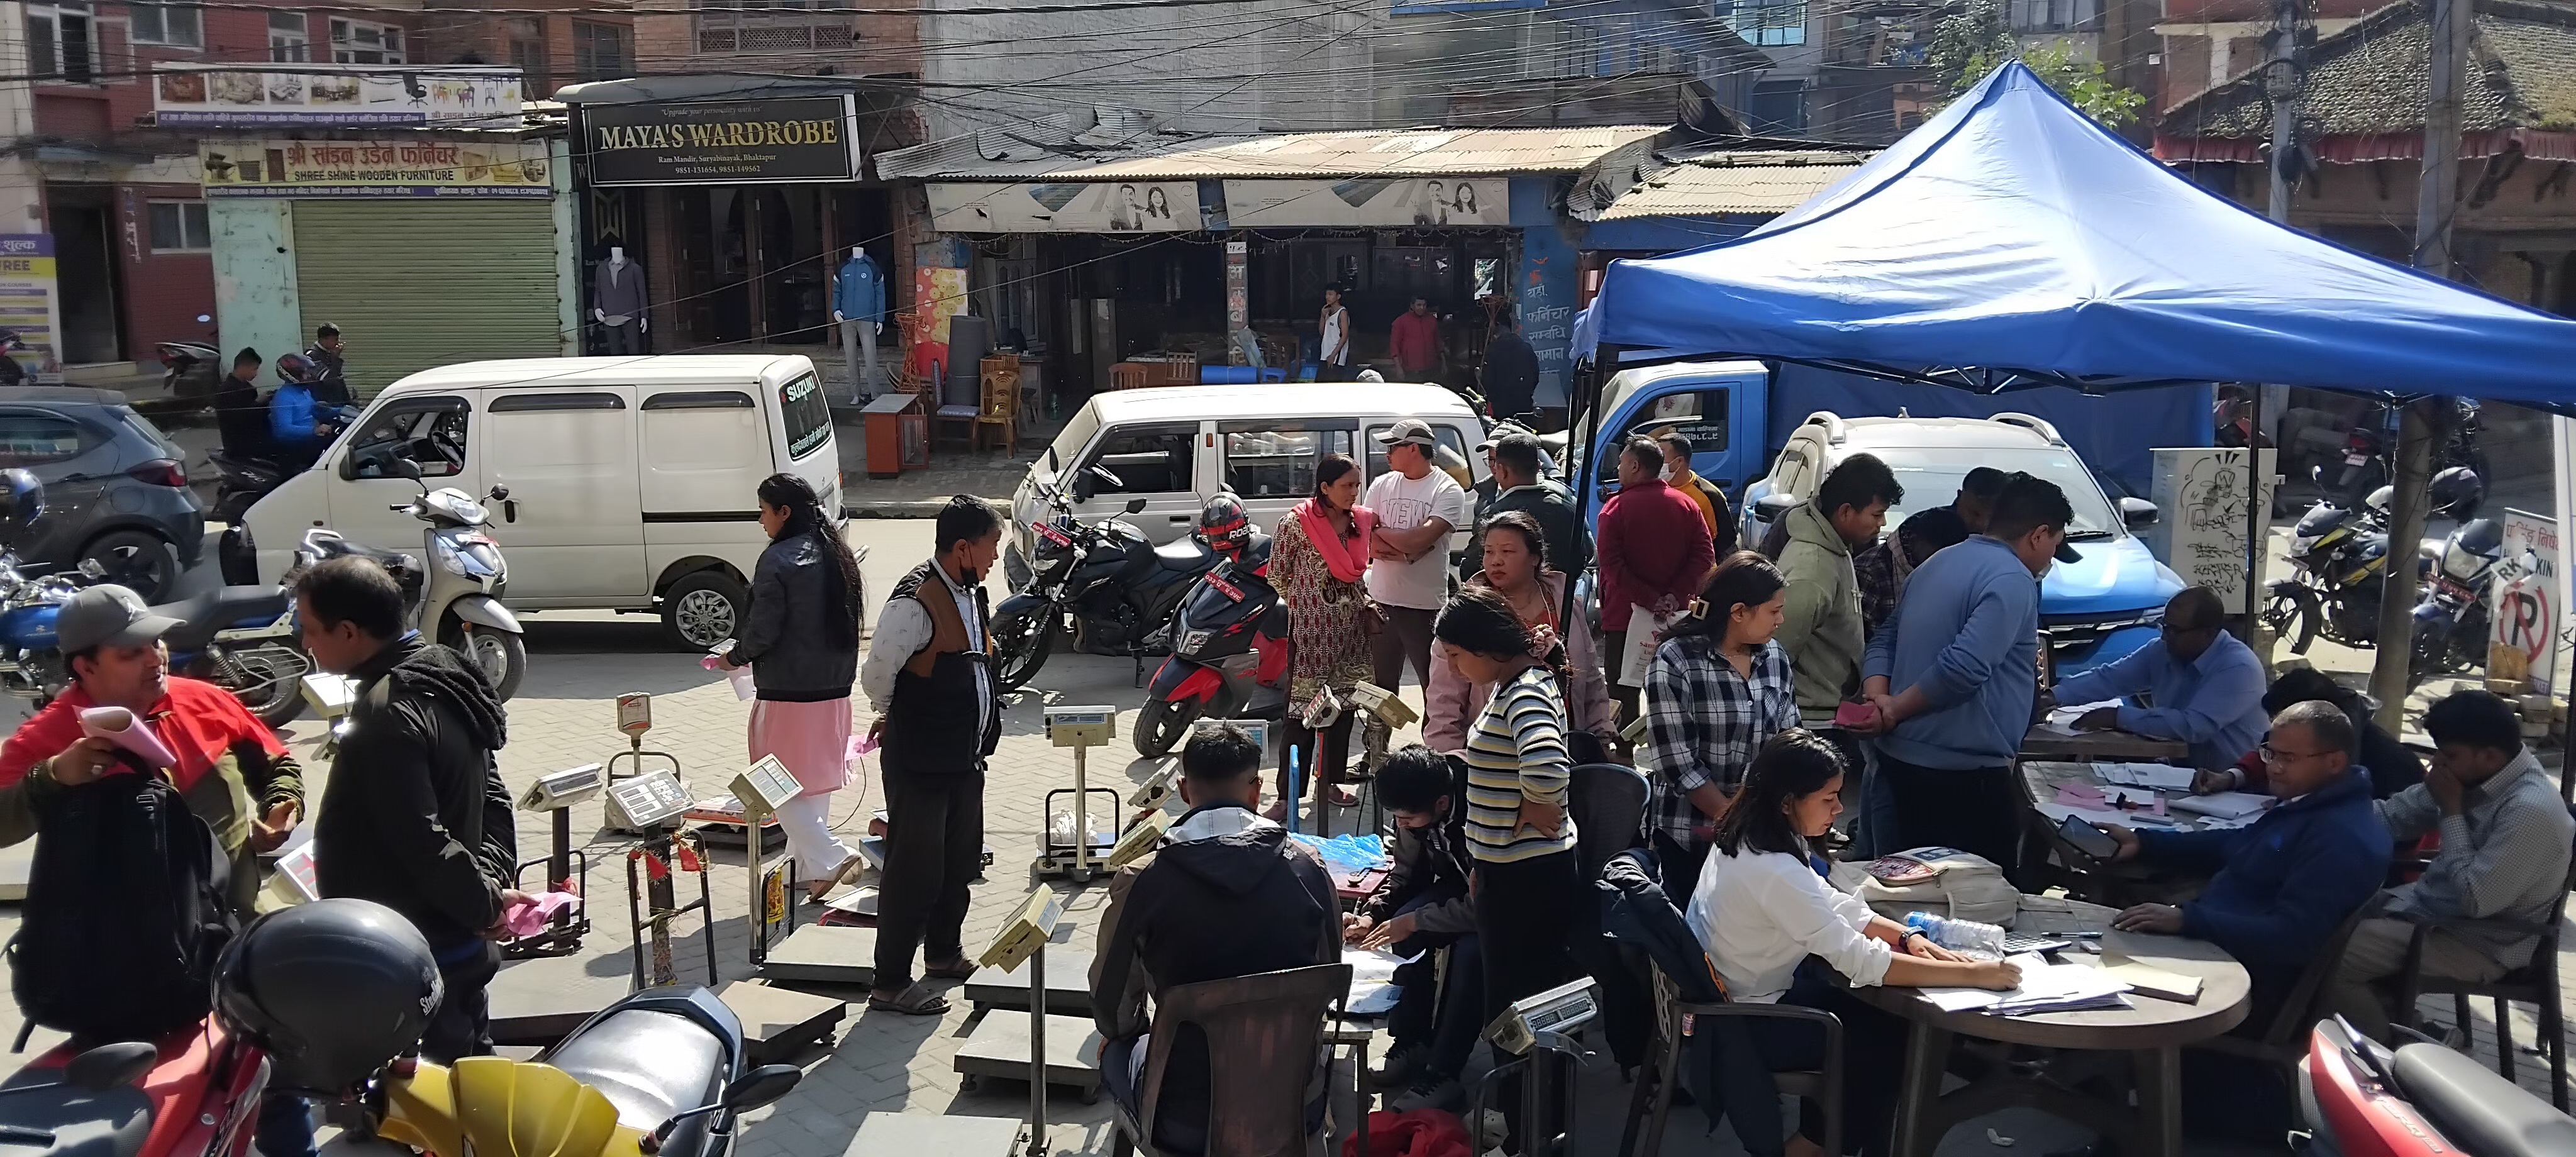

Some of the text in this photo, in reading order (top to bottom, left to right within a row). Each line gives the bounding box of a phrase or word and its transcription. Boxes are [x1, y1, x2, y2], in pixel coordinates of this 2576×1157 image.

[704, 107, 736, 116] personality
[599, 119, 838, 150] MAYA'S WARDROBE
[287, 141, 306, 166] श्री
[359, 140, 395, 165] उडेन
[400, 141, 460, 165] फर्निचर
[674, 155, 699, 163] Mandir,
[743, 153, 777, 162] Bhaktapur
[295, 170, 453, 181] SHREE SHINE WOODEN FURNITURE
[675, 165, 761, 174] 9851-131654, 9851-149562
[0, 260, 30, 271] REE
[1526, 304, 1570, 323] फर्निचर
[787, 375, 816, 402] SUZUKI
[1381, 497, 1433, 530] NEW
